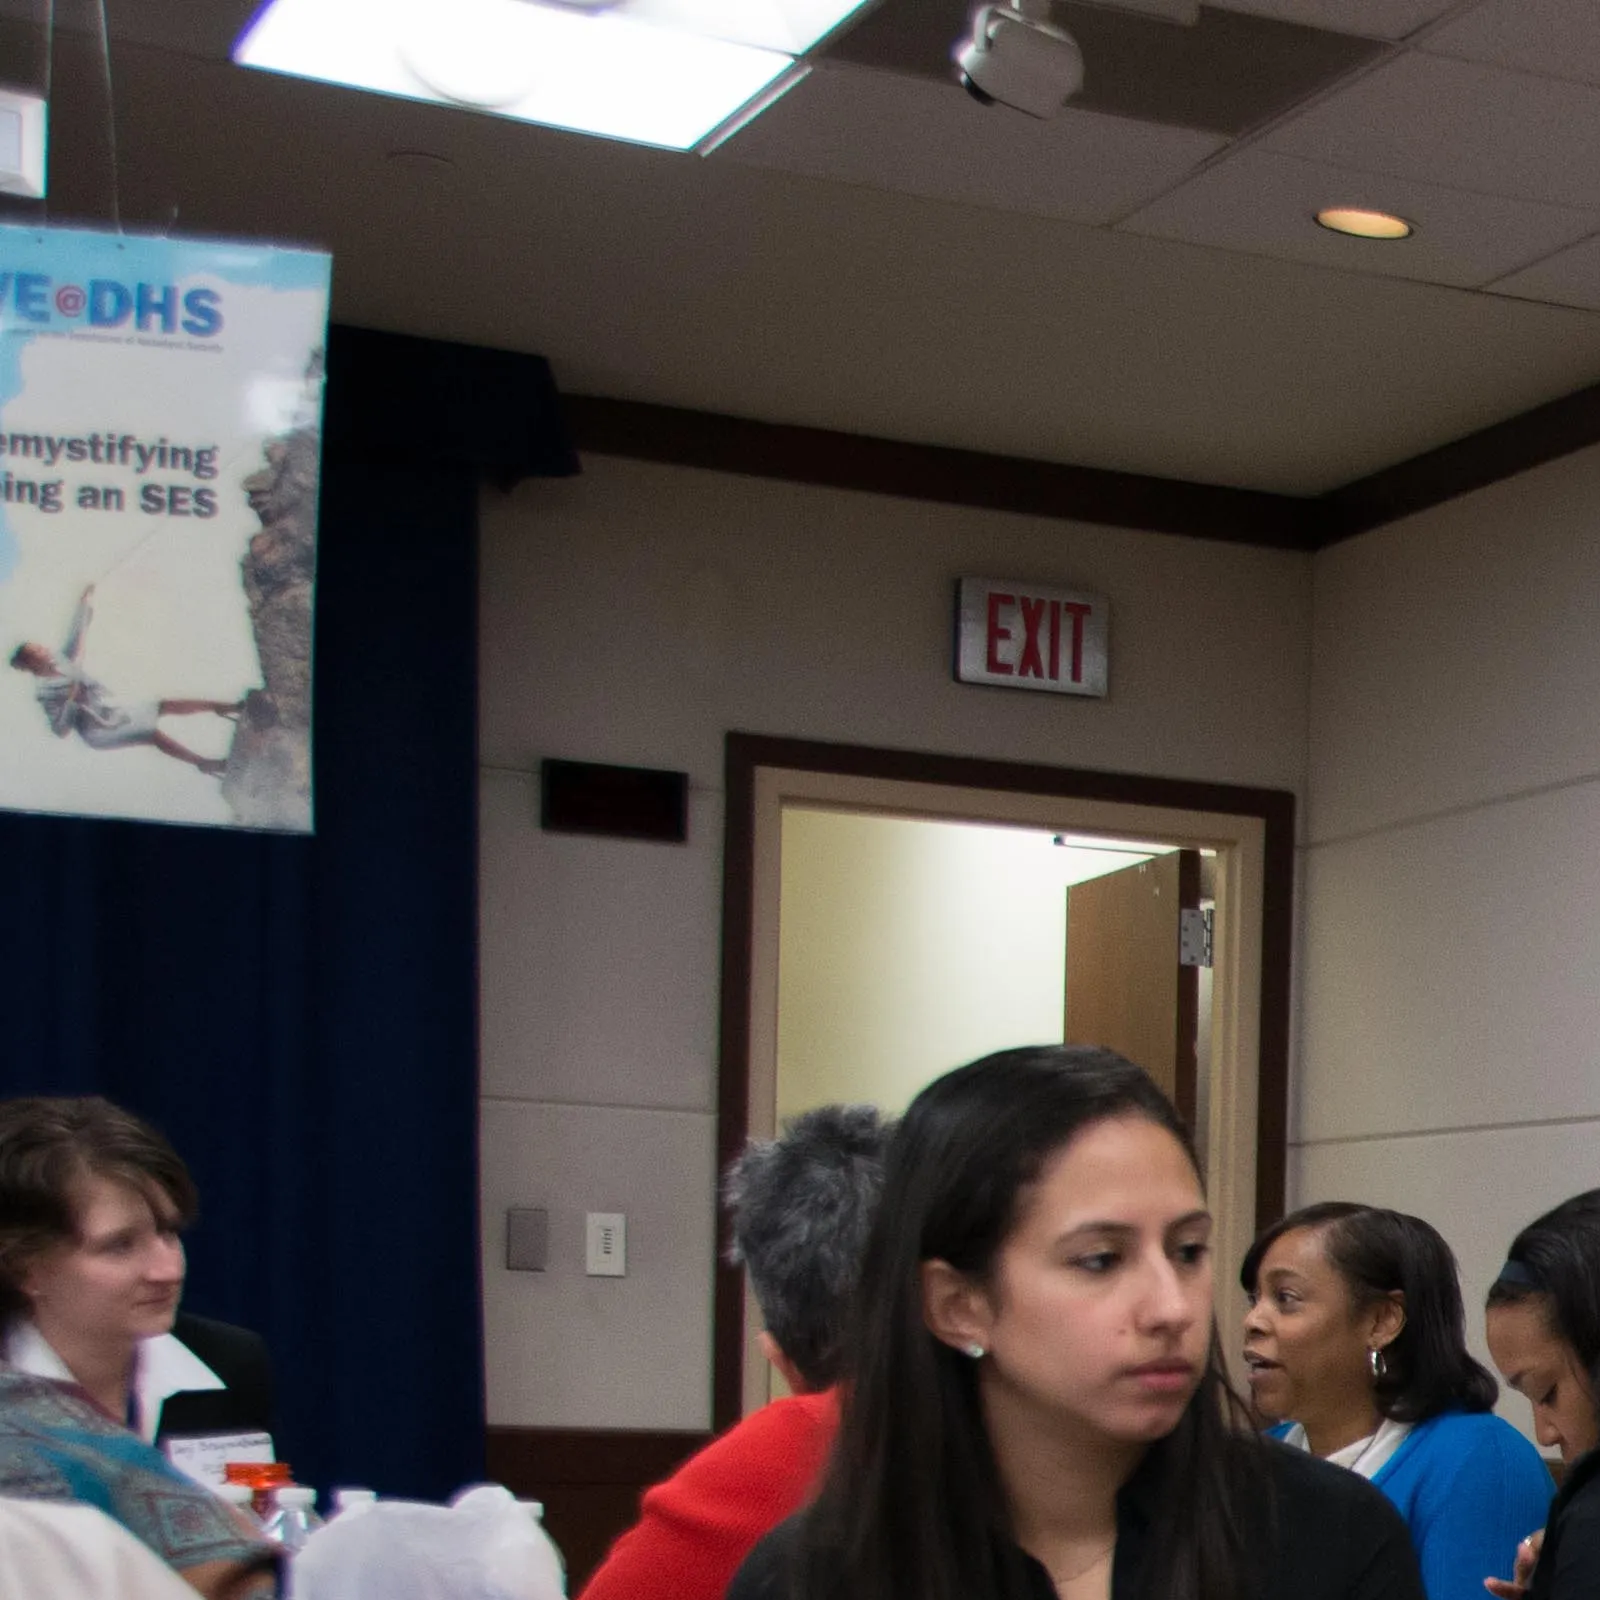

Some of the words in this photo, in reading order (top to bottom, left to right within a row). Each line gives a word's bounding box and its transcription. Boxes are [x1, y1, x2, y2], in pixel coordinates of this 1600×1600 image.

[0, 471, 64, 513] ing
[77, 484, 125, 511] an
[139, 484, 219, 519] SES
[986, 592, 1092, 684] EXIT
